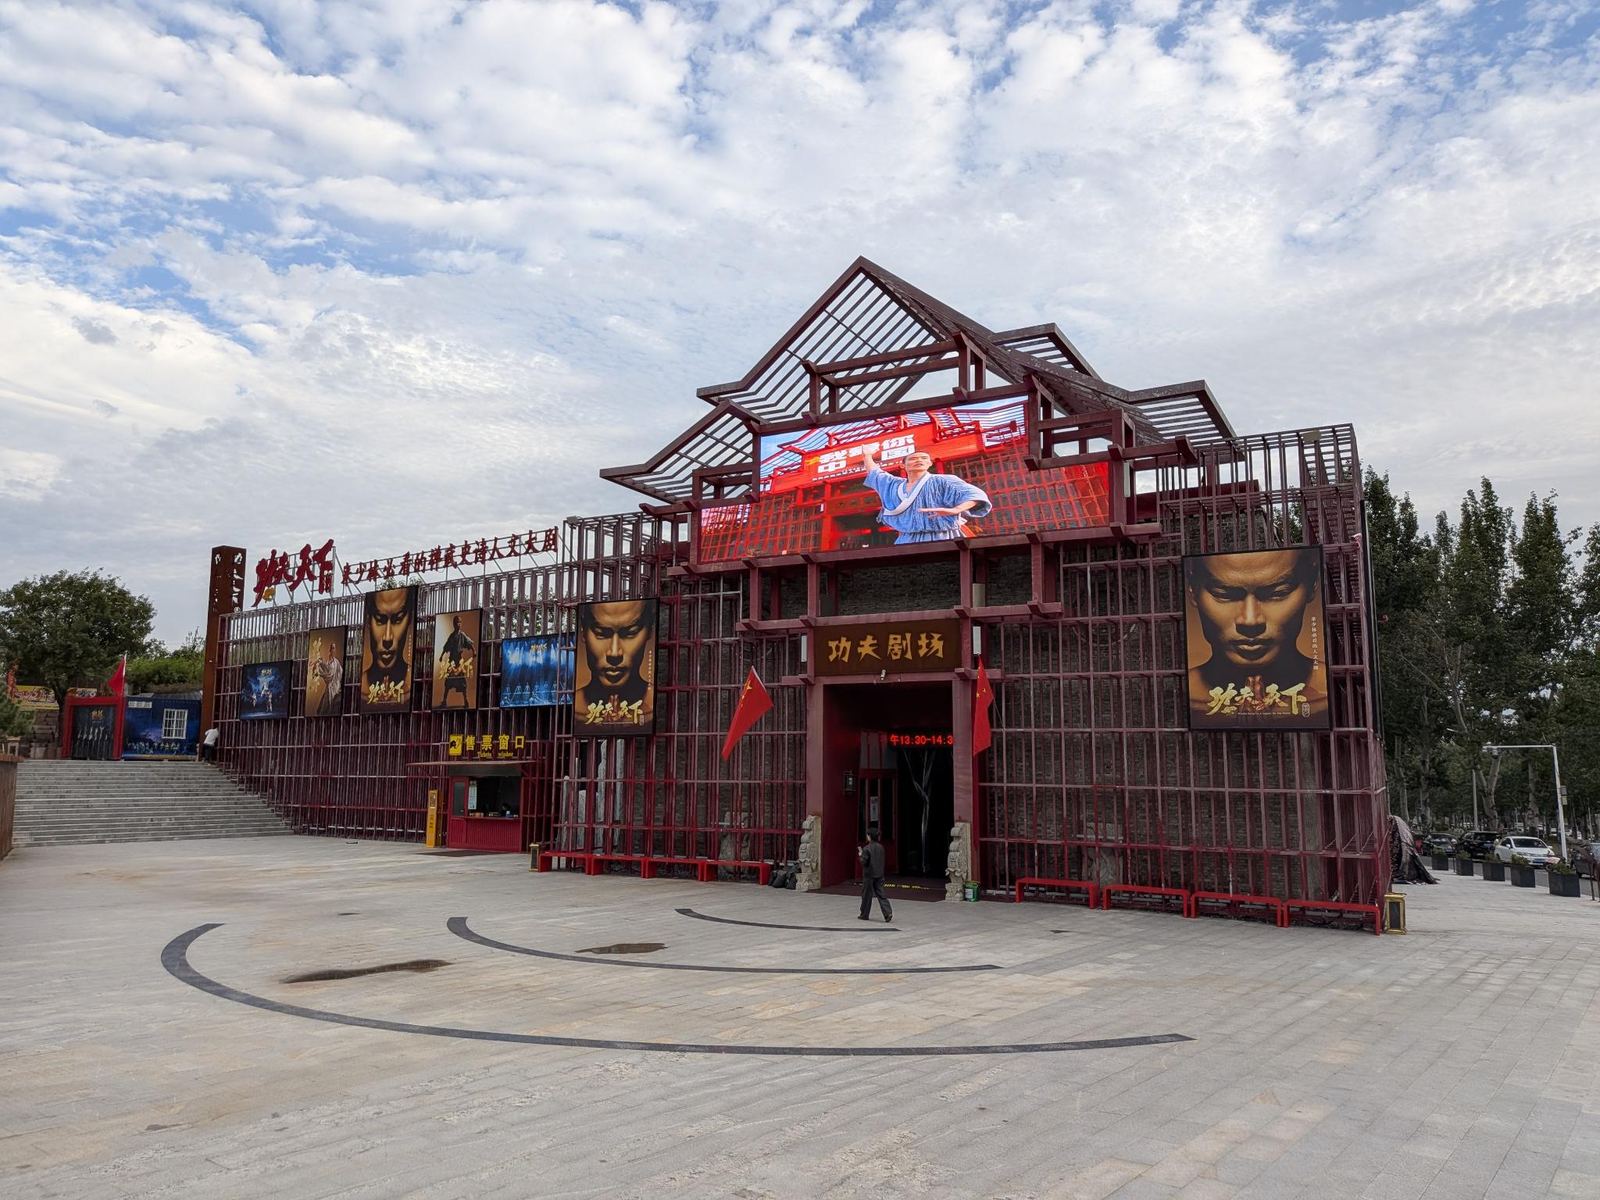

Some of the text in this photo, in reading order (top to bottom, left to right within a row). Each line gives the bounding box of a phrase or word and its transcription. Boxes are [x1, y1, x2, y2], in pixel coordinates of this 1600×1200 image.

[828, 632, 945, 663] 功夫剧场
[466, 734, 525, 751] 售票窗口
